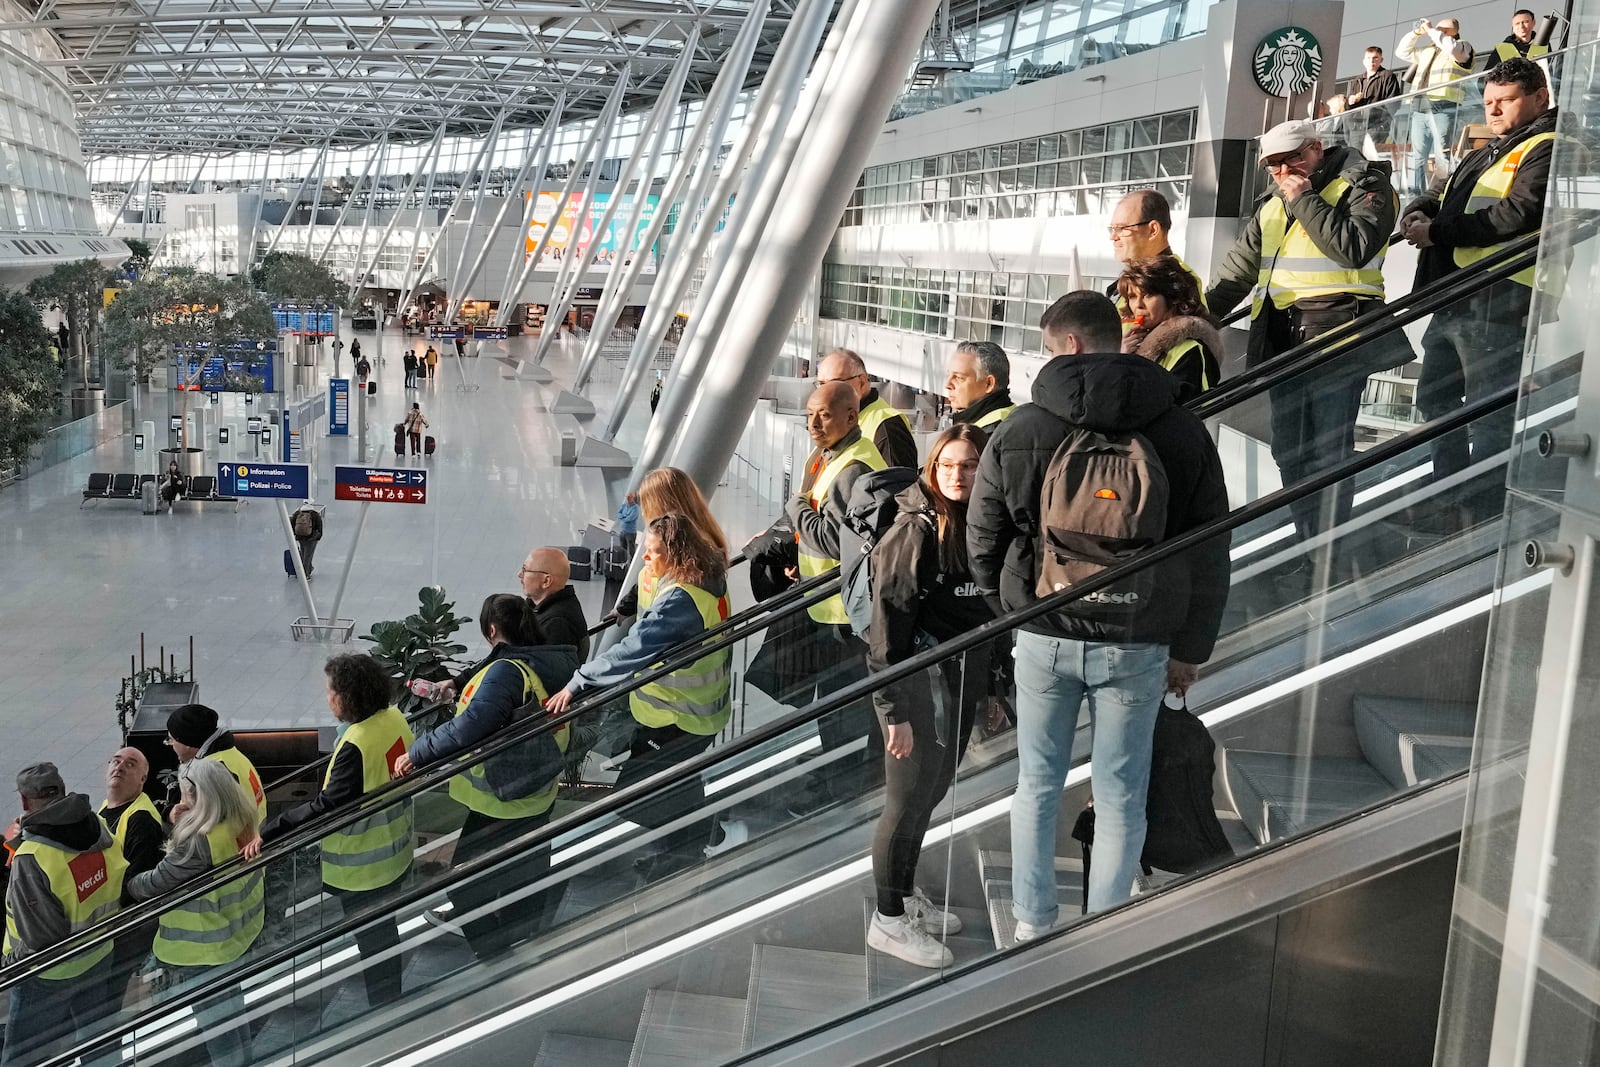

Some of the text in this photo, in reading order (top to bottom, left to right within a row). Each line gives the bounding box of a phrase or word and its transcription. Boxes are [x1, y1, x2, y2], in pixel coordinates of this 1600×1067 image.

[250, 468, 285, 476] Information
[954, 582, 979, 597] elle
[1054, 582, 1139, 604] eesse
[78, 868, 104, 892] ver.di
